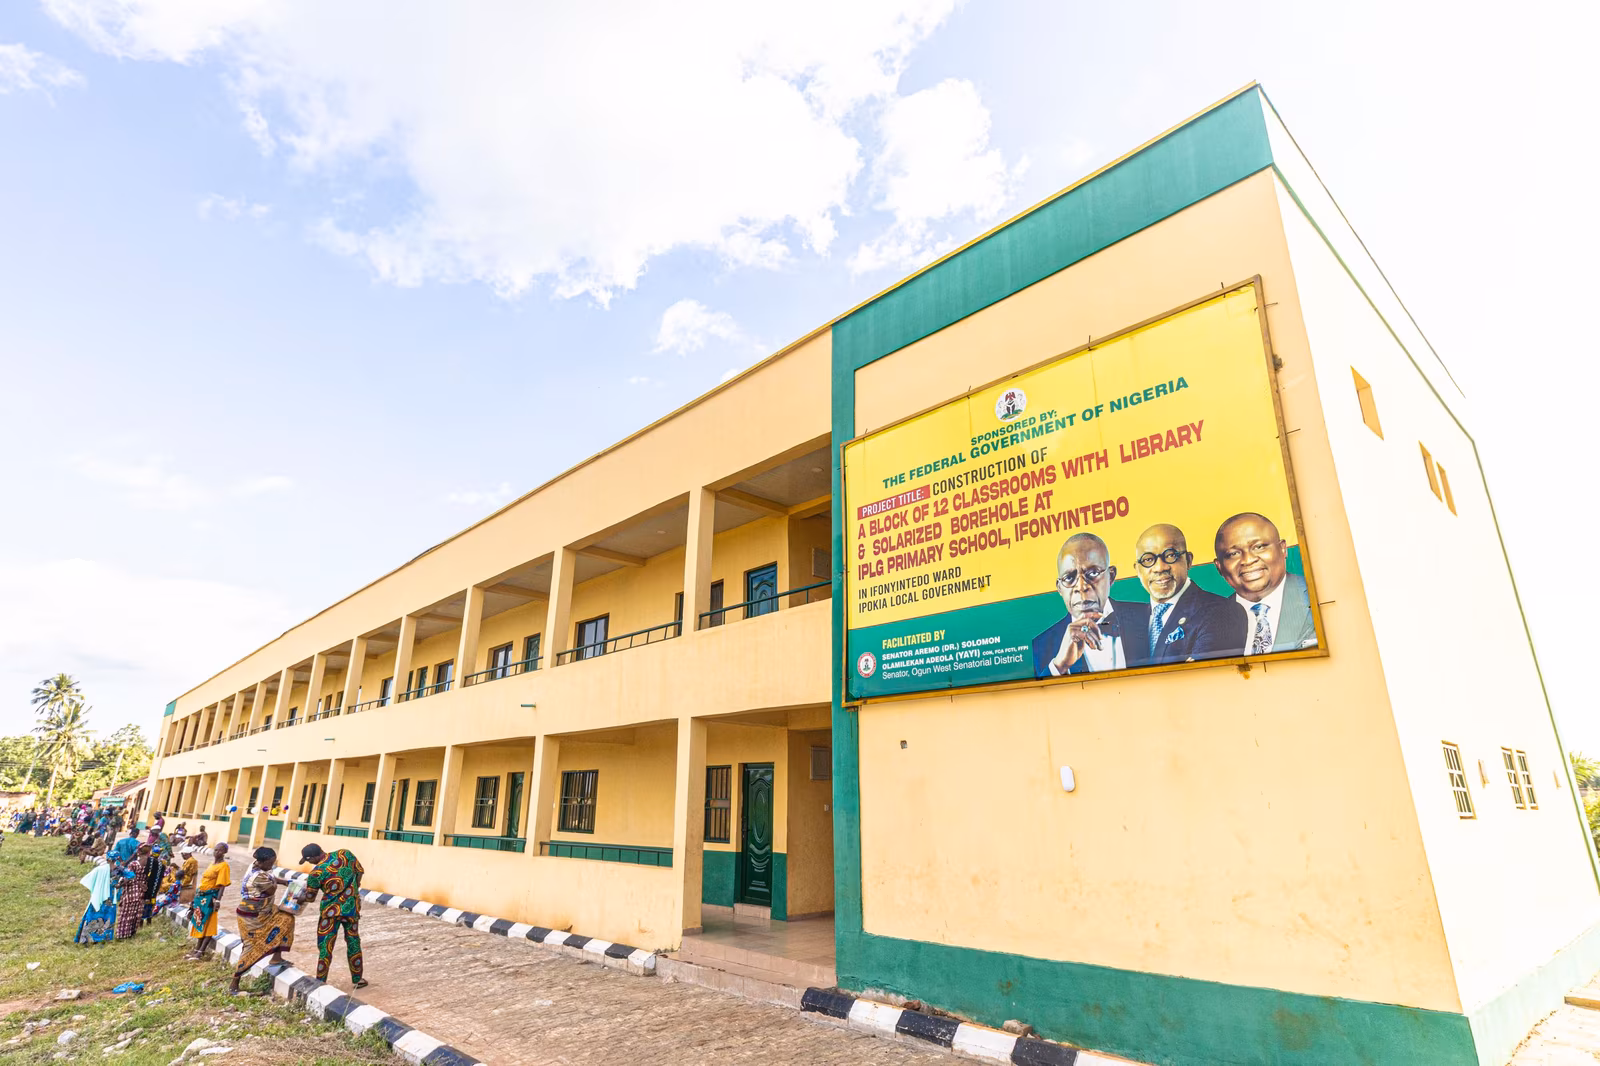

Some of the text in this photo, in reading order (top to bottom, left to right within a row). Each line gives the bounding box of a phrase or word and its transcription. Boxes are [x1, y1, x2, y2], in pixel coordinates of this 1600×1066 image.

[882, 376, 1189, 488] THE FEDERAL GOVERNMENT OF NIGERIA
[971, 410, 1057, 446] SPONSORED BY:
[857, 419, 1204, 540] A BLOCK OF 12 CLASSROOMS WITH LIBRARY
[862, 446, 1047, 517] PROJECT TITLE: CONSTRUCTION OF
[858, 489, 1053, 560] & SOLARIZED BOREHOLE AT
[858, 496, 1129, 581] IPLG PRIMARY SCHOOL, IFONYINTEDO
[859, 566, 961, 600] IN IFONYINTEDO WARD
[859, 574, 992, 613] IPOKIA LOCAL GOVERNMENT
[882, 629, 946, 649] FACILITATED BY
[882, 636, 1001, 661] SENATOR AREMO (DR.) SOLOMON
[882, 658, 924, 670] OLAMILEKAN
[925, 654, 954, 664] ADEOLA
[955, 649, 980, 661] (YAYI)
[882, 653, 1023, 680] Senator, Ogun West Senatorial District
